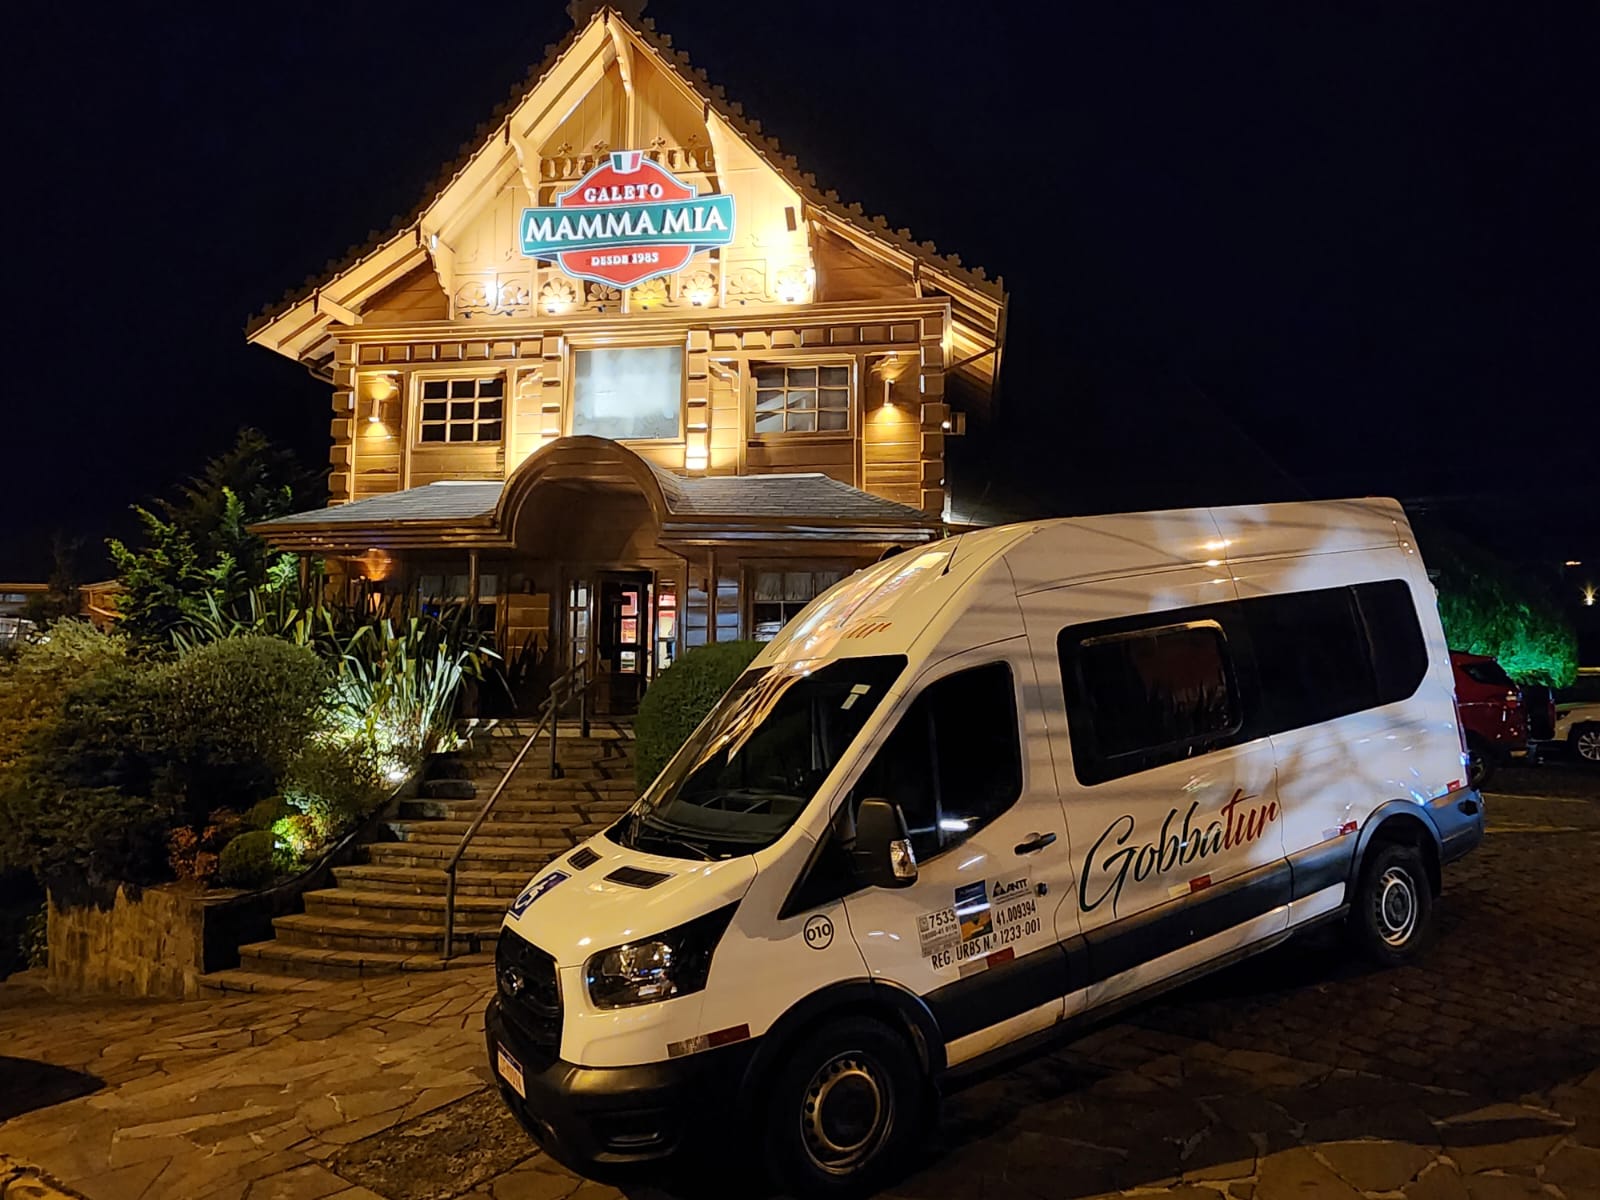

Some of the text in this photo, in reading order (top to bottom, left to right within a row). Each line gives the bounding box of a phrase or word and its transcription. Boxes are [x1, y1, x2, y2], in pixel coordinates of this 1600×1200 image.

[584, 183, 663, 203] GALETO
[525, 205, 727, 242] MAMMA MIA
[591, 251, 659, 267] DESDE 1985
[1006, 878, 1028, 893] ANTT
[928, 909, 956, 929] 7533
[996, 899, 1036, 926] 41.009394
[806, 923, 831, 942] 010
[931, 951, 954, 971] REG.
[956, 939, 981, 961] URBS
[1000, 917, 1041, 945] 1233-001
